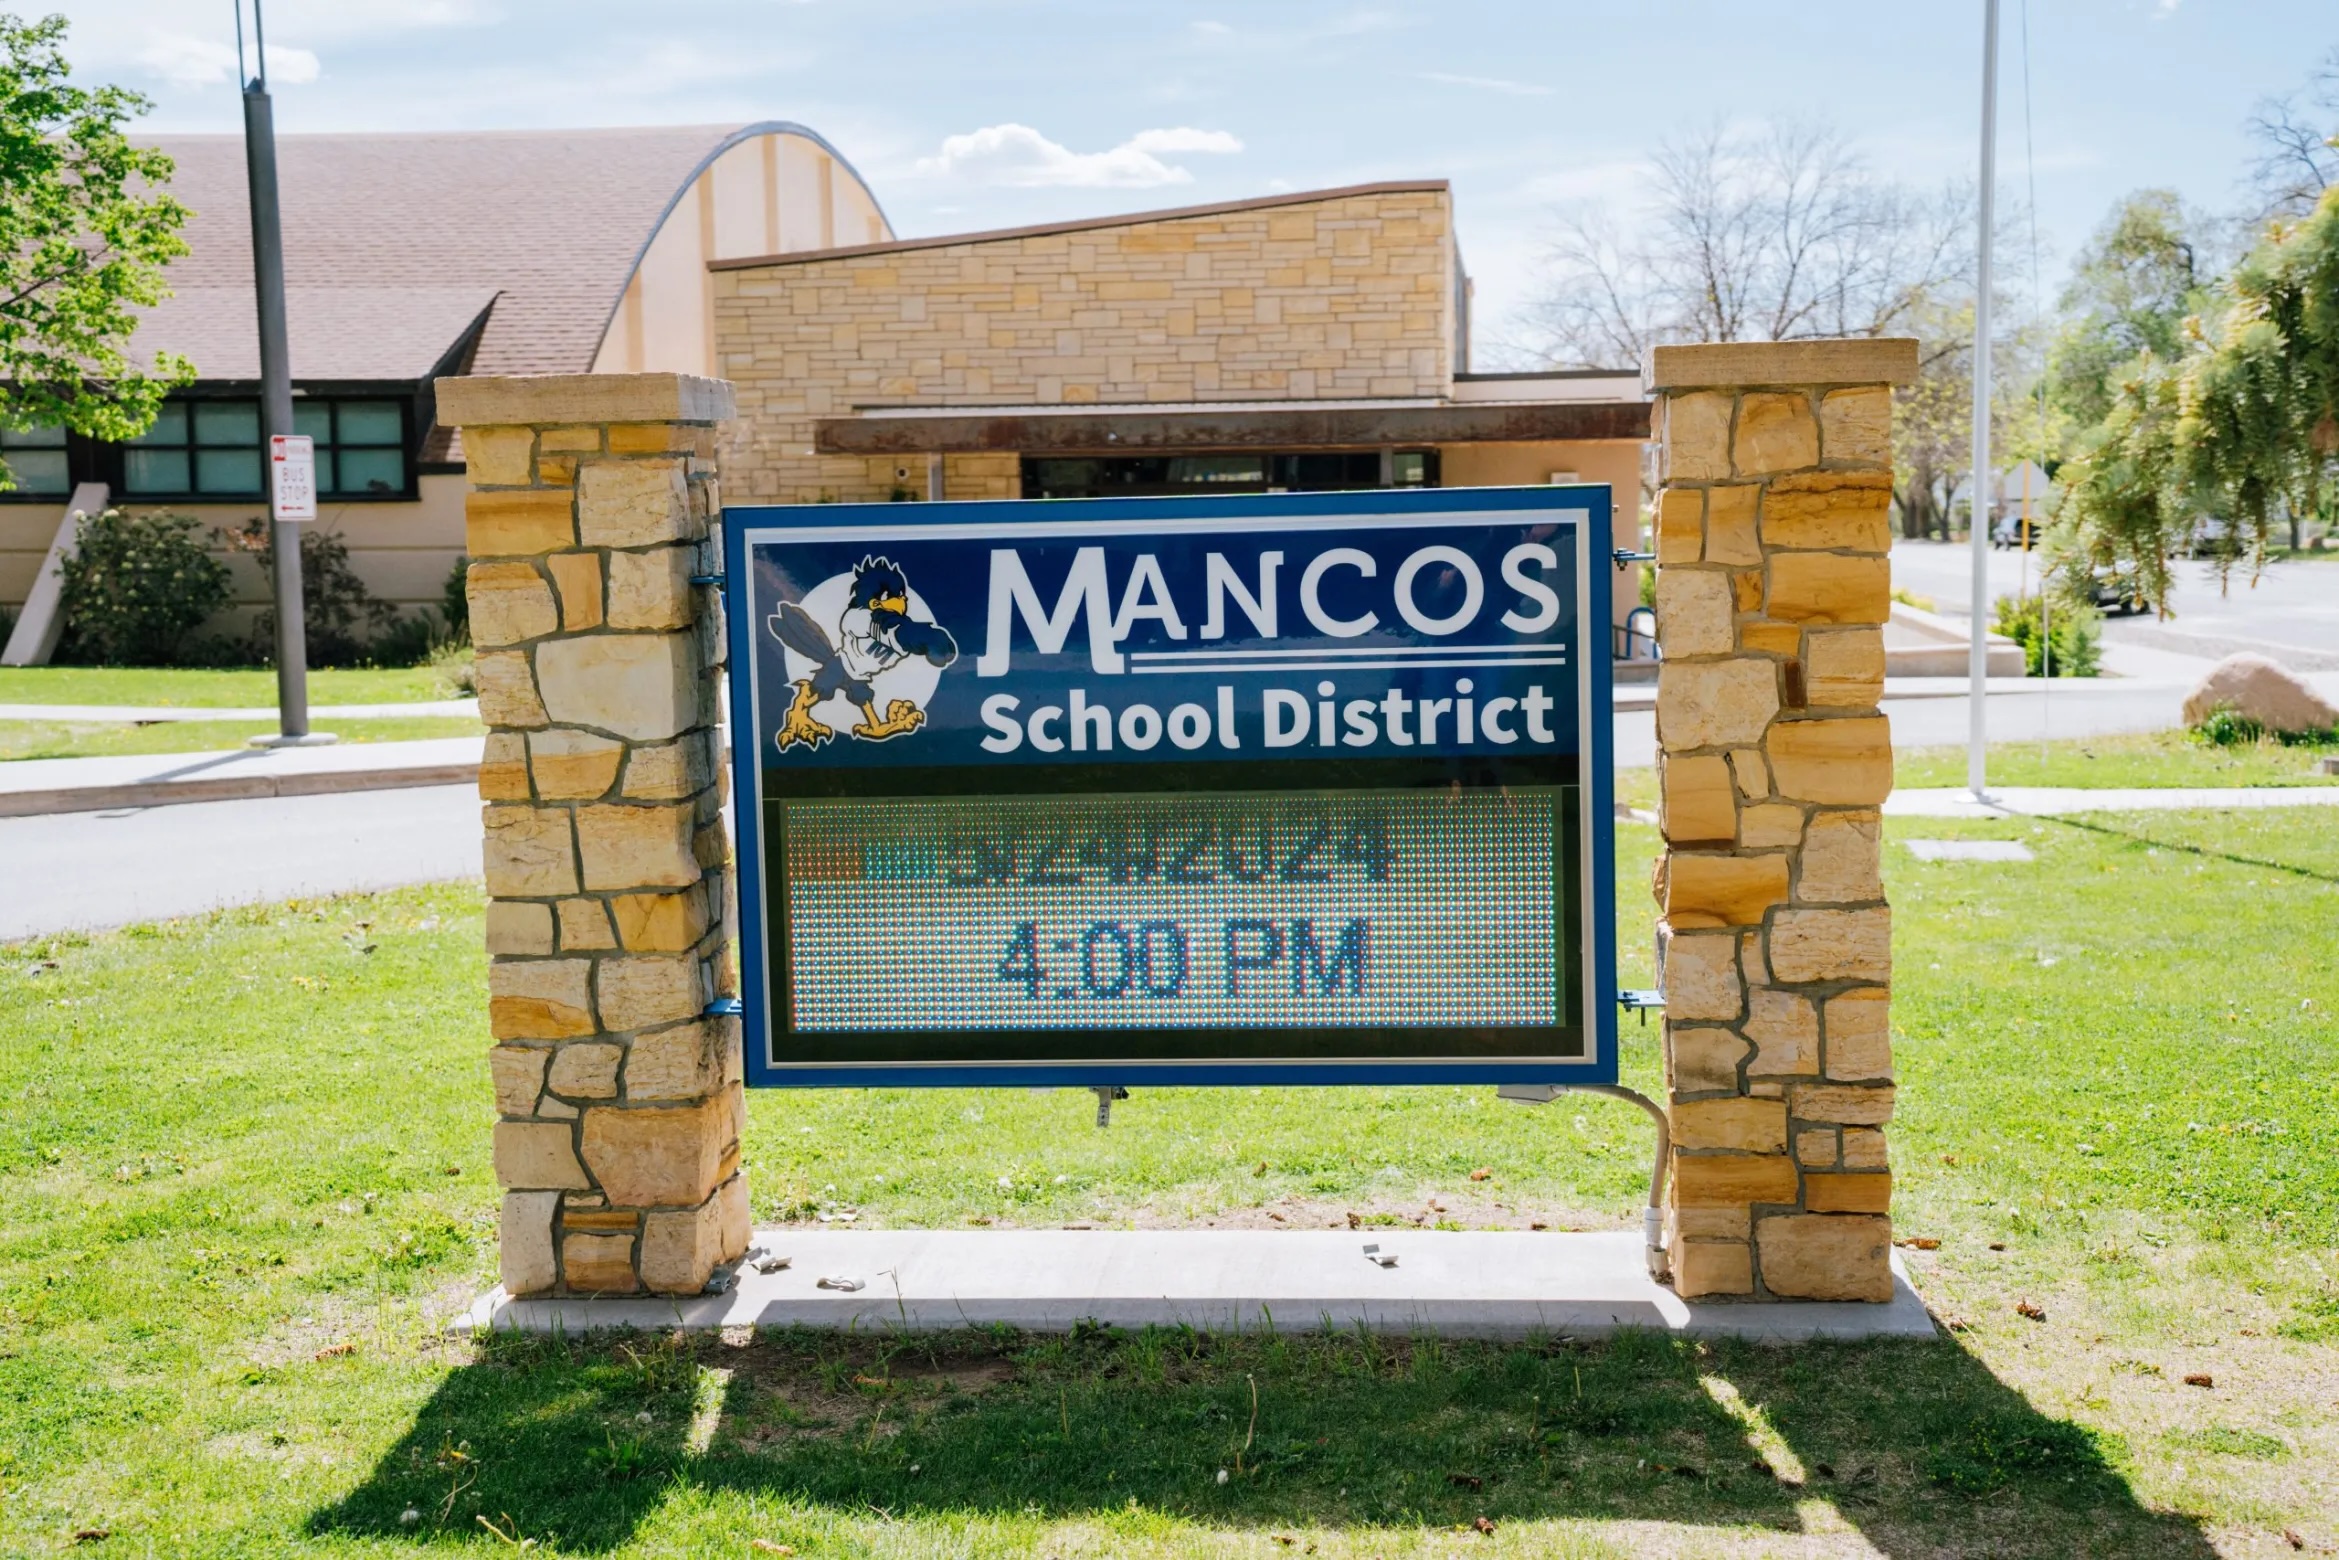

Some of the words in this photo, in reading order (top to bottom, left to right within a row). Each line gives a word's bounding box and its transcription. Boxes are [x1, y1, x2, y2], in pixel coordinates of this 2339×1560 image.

[281, 485, 309, 500] STOP
[282, 467, 305, 482] BUS
[977, 544, 1561, 676] MANCOS
[979, 685, 1241, 754] School
[1263, 680, 1556, 750] District
[996, 919, 1188, 999] 4:00
[1224, 917, 1370, 998] PM
